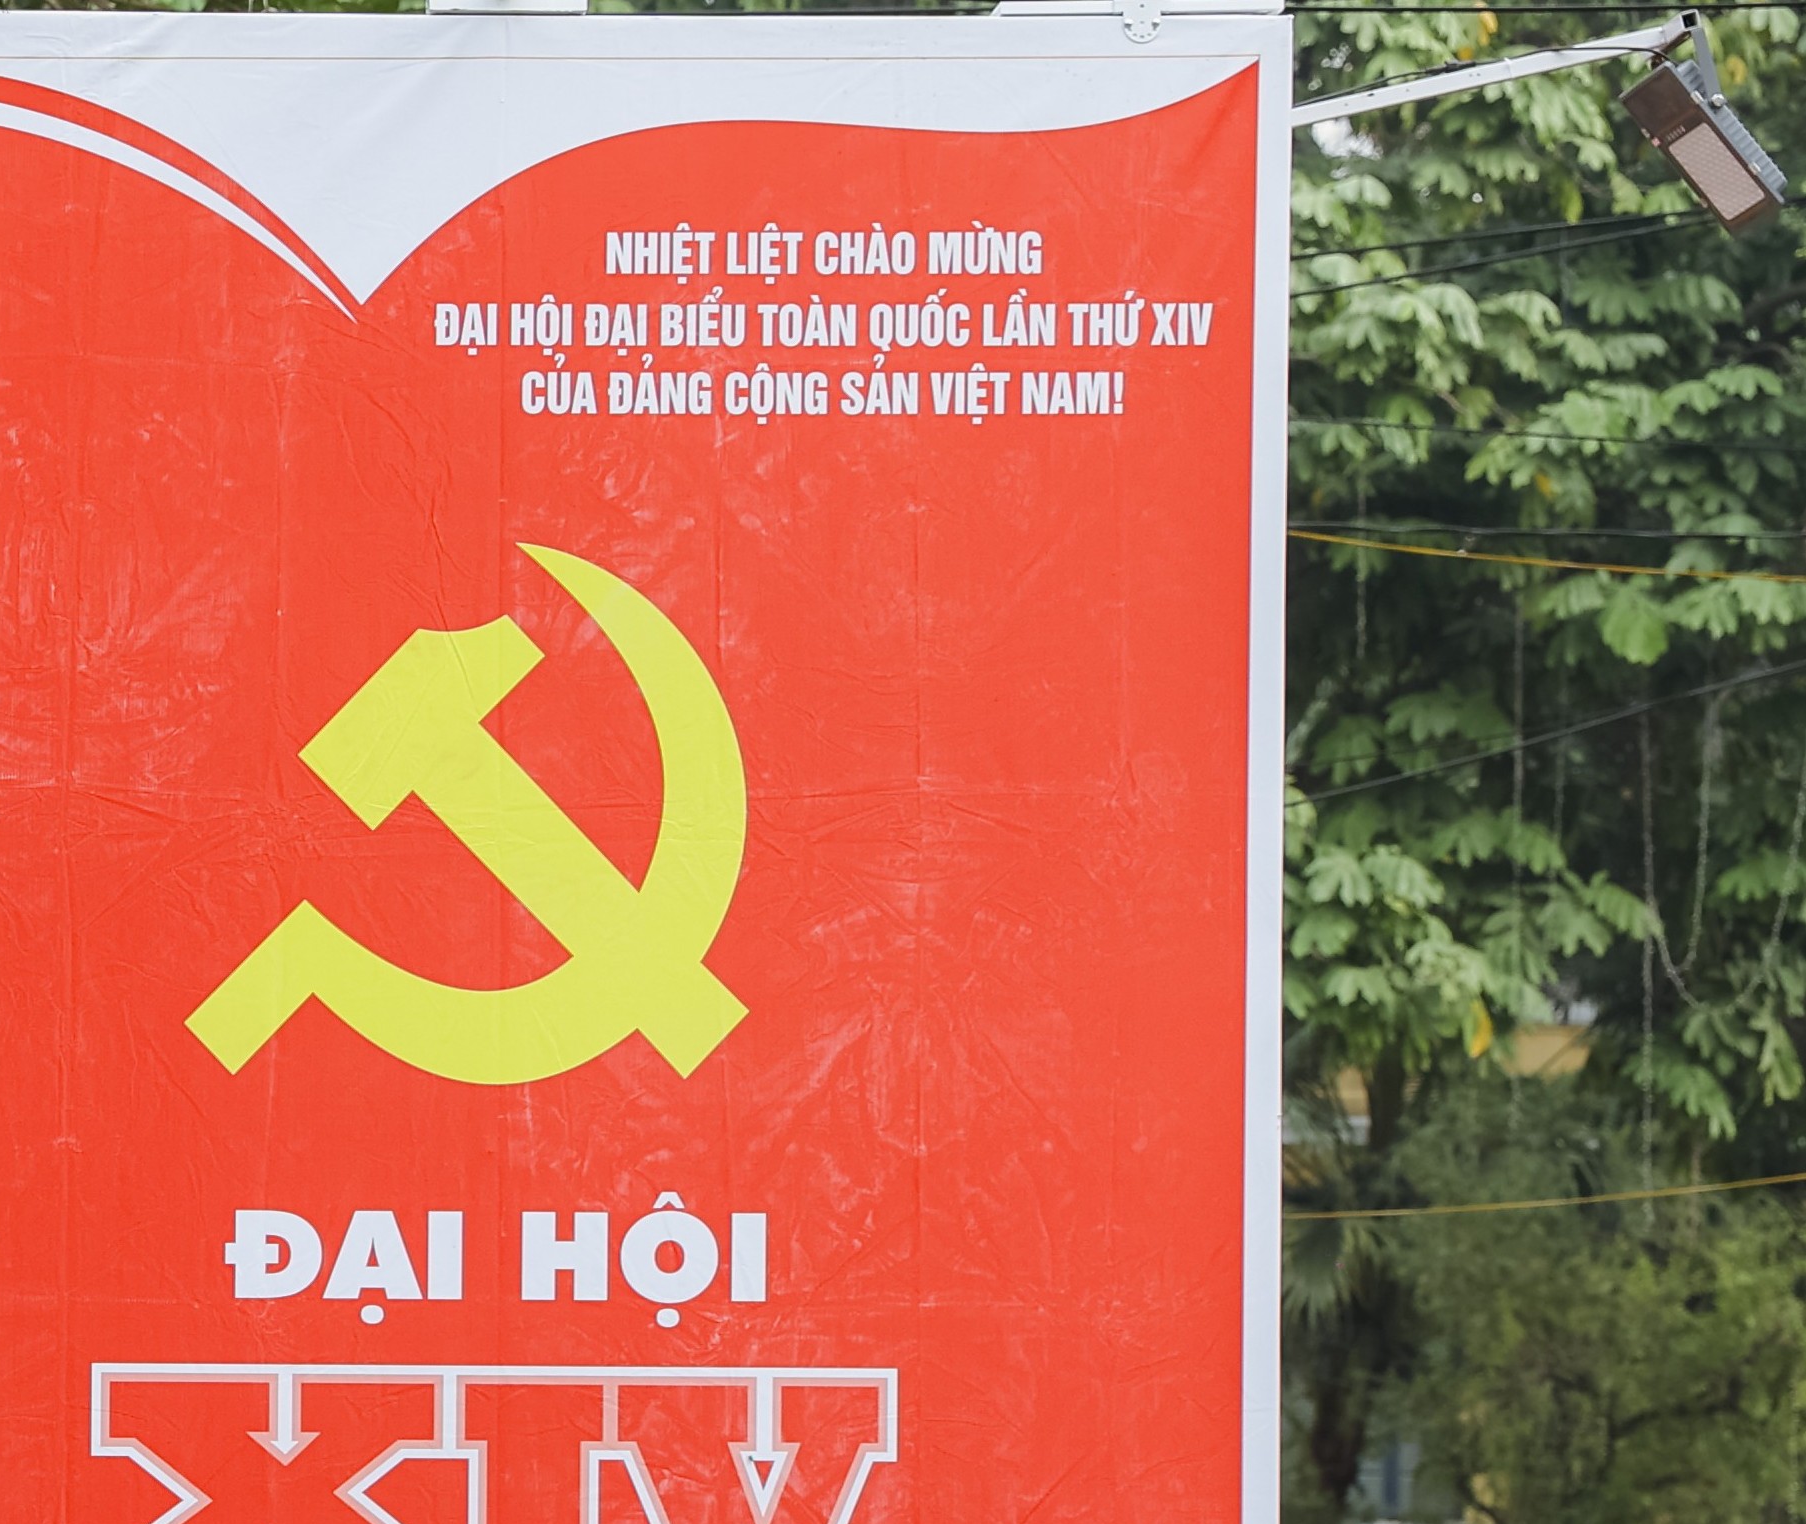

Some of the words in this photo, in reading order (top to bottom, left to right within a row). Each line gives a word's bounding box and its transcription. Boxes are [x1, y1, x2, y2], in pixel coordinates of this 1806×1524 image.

[606, 223, 715, 284] NHIỆT
[727, 223, 803, 284] LIỆT
[815, 223, 915, 274] CHÀO
[929, 221, 1042, 274] MỪNG
[434, 304, 497, 355] ĐẠI
[511, 295, 572, 355] HỘI
[584, 304, 649, 357] ĐẠI
[661, 286, 745, 346] BIỂU
[758, 295, 856, 346] TOÀN
[870, 289, 970, 351] QUỐC
[983, 289, 1055, 346] LẦN
[1068, 290, 1144, 346] THỨ
[1151, 303, 1213, 345] XIV
[522, 353, 597, 414] CỦA
[608, 354, 712, 414] ĐẢNG
[725, 363, 827, 424] CỘNG
[841, 354, 918, 415] SẢN
[931, 363, 1010, 424] VIỆT
[1022, 372, 1123, 414] NAM!
[225, 1210, 462, 1324] ĐẠI
[522, 1192, 766, 1327] HỘI
